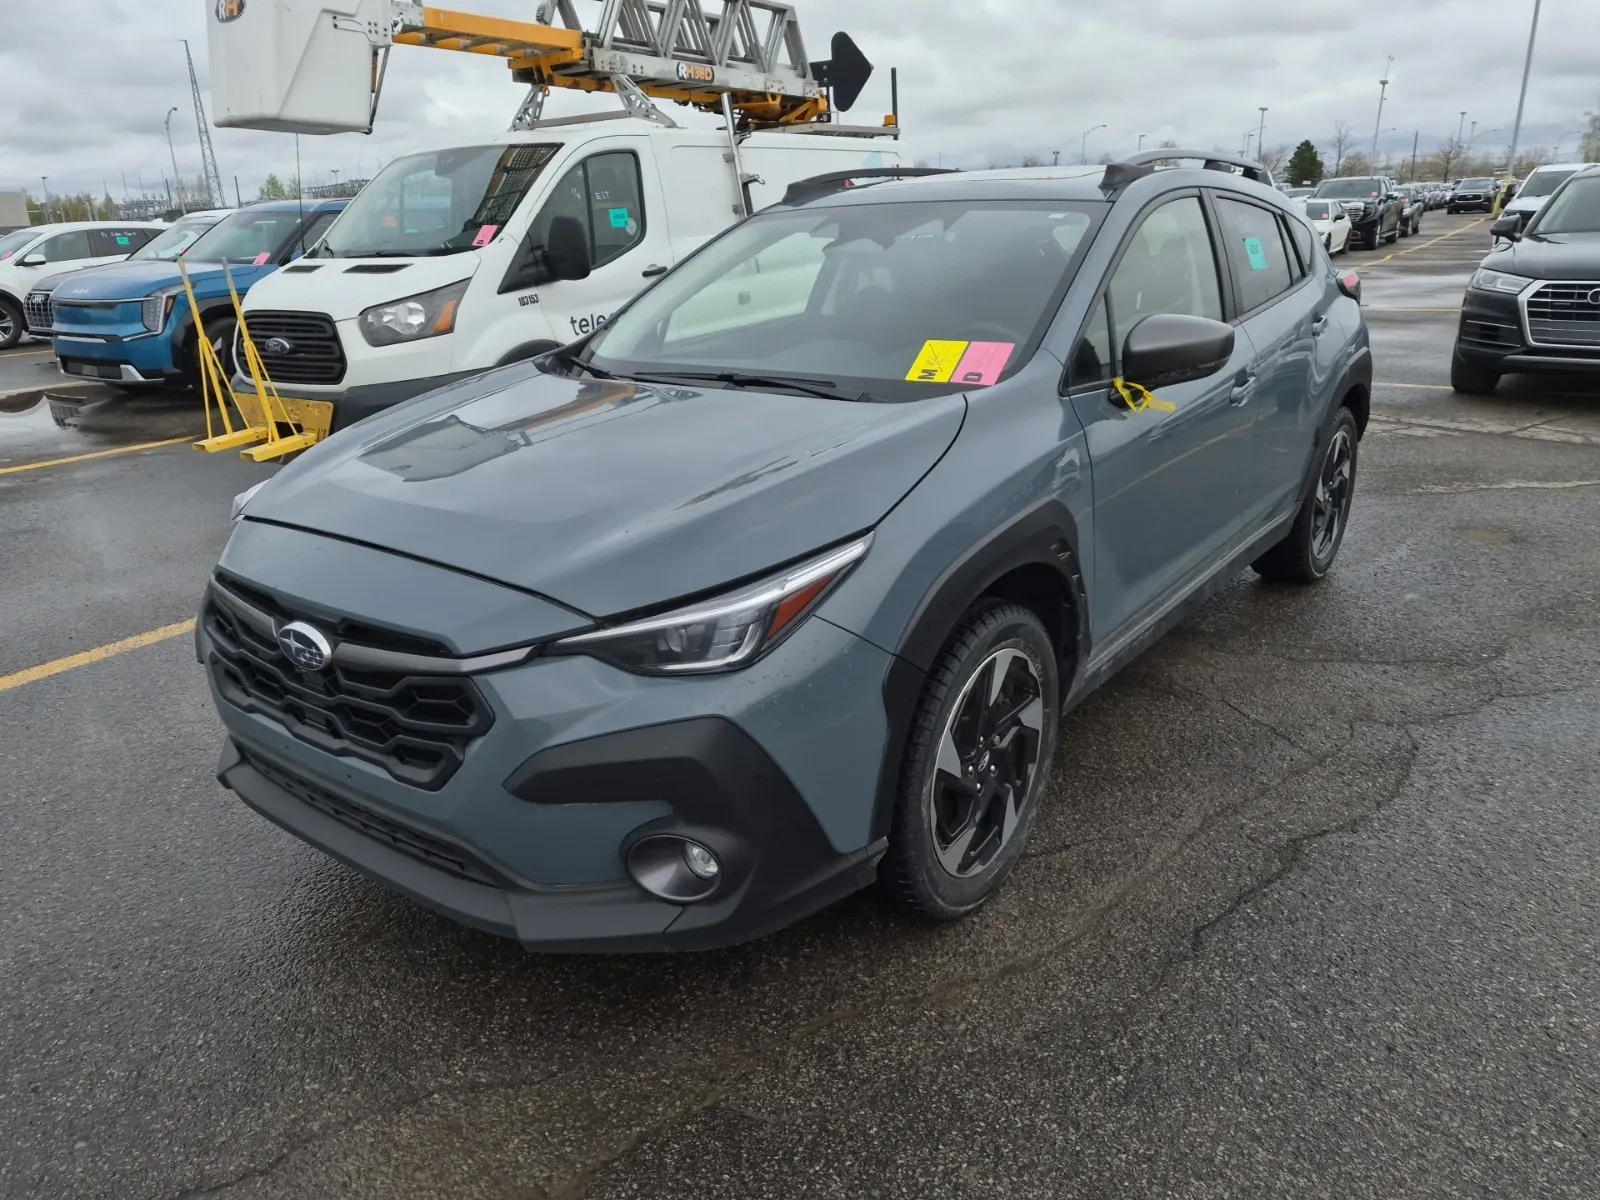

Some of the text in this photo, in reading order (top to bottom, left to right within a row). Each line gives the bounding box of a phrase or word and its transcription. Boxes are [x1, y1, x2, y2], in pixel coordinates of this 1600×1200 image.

[218, 0, 238, 20] RH
[679, 63, 713, 81] RH38D
[518, 294, 539, 307] 103153
